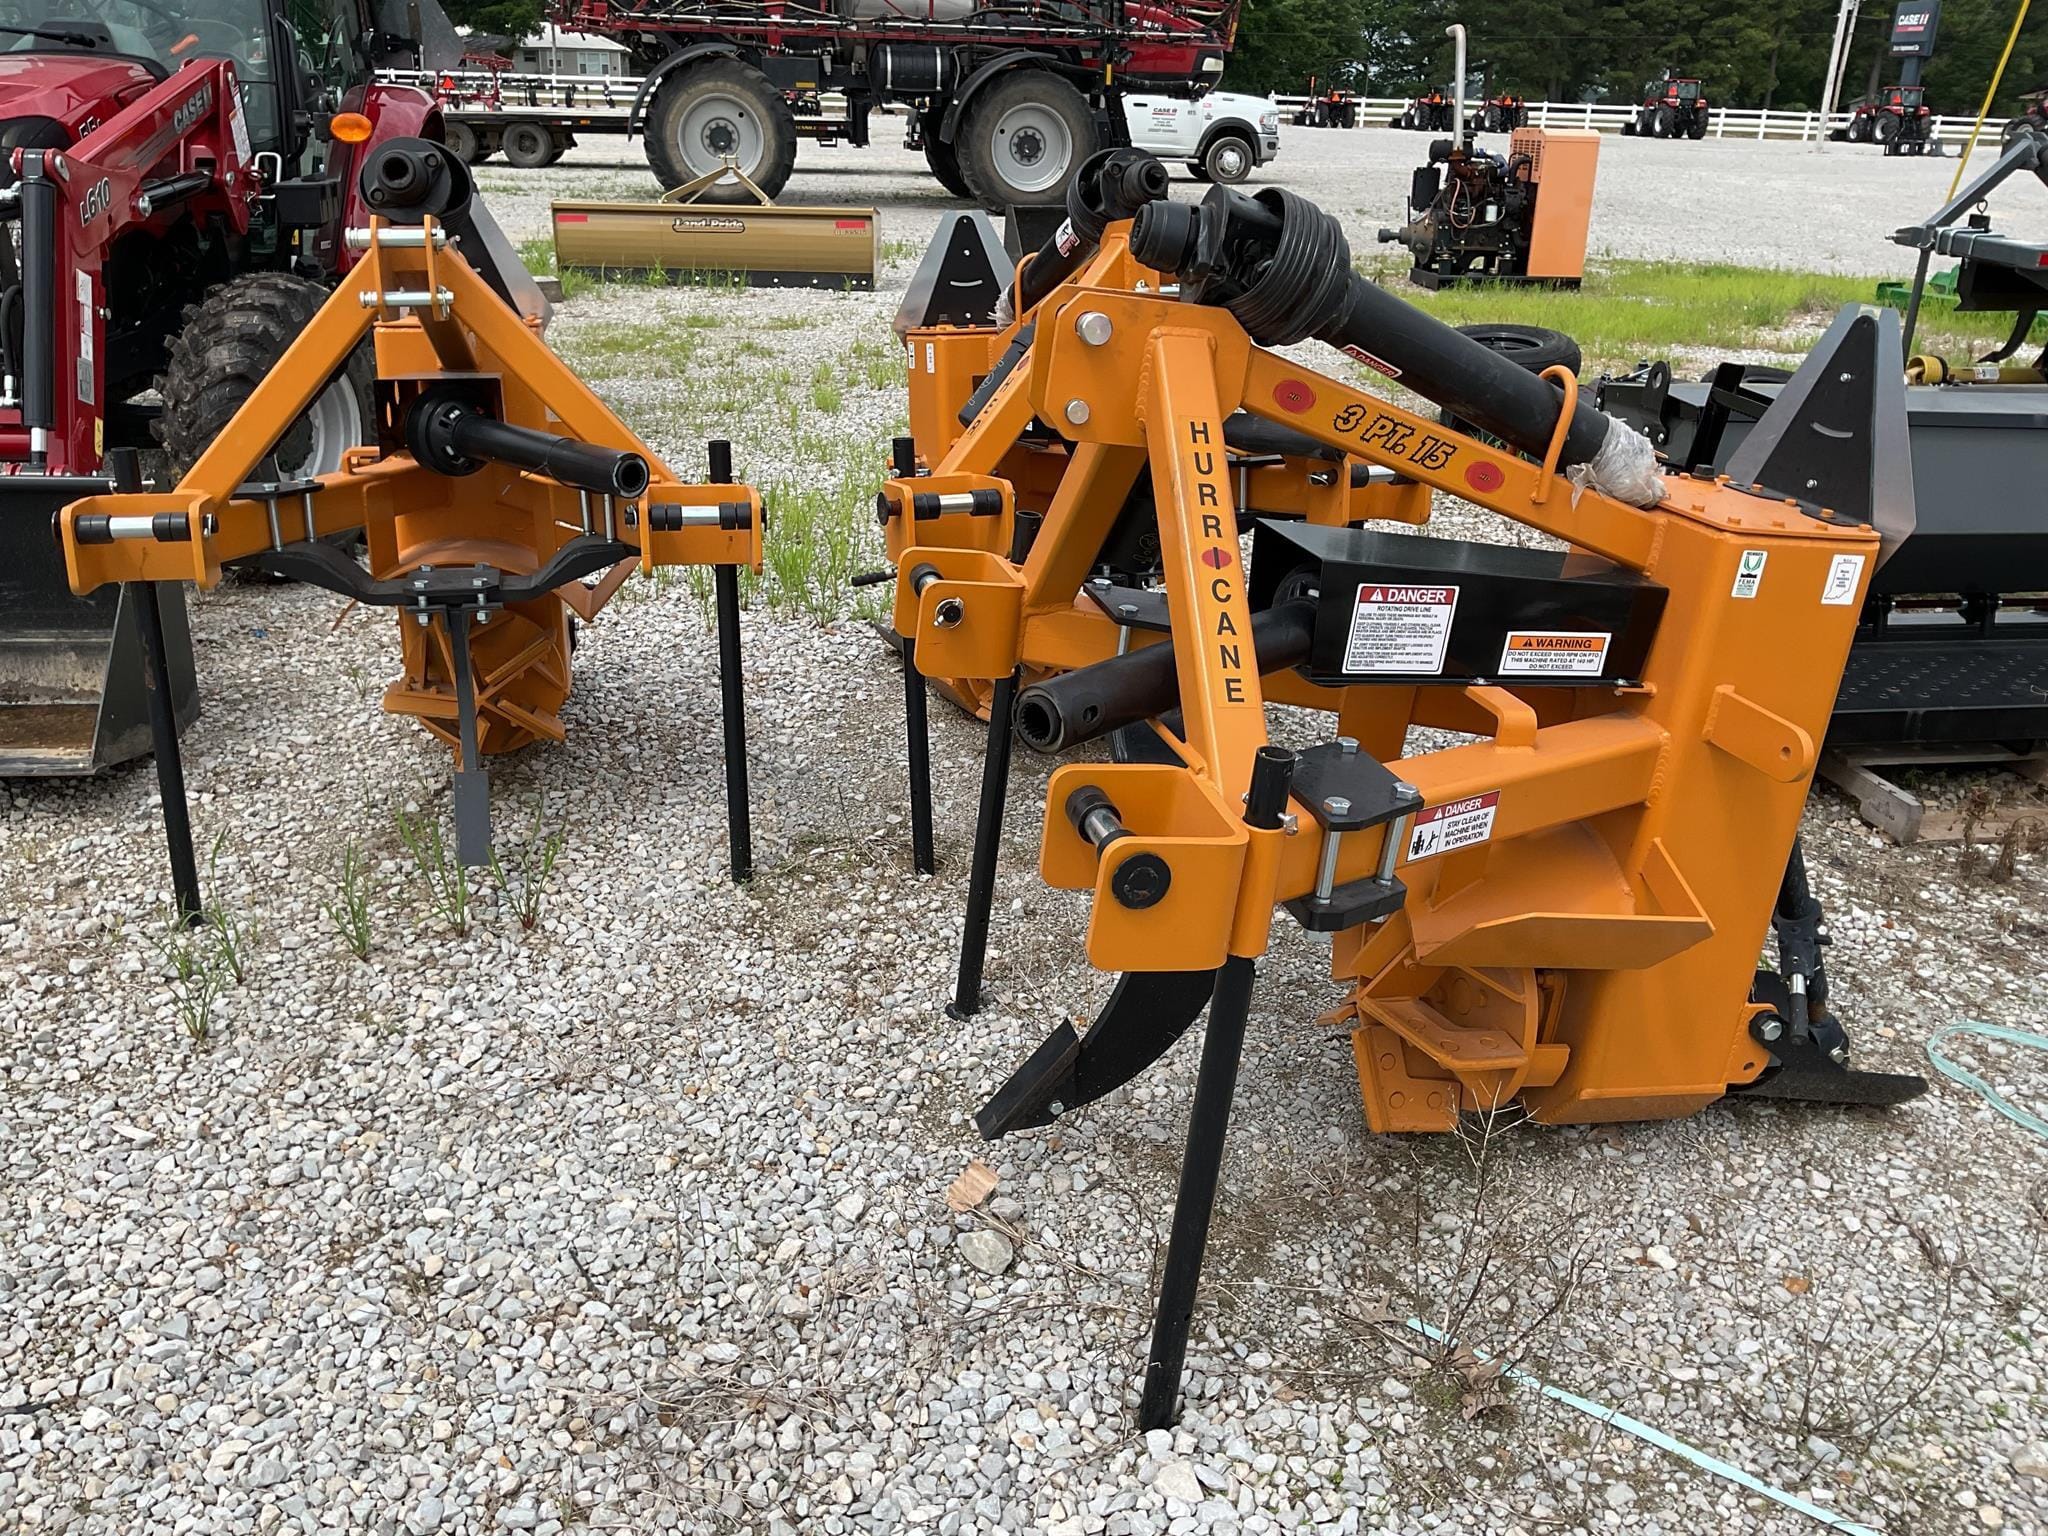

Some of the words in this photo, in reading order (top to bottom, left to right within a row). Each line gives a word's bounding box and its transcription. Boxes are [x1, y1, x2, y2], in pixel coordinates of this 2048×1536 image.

[1898, 14, 1920, 25] CASE
[173, 95, 206, 134] CASE
[80, 177, 111, 228] L610
[1355, 354, 1396, 377] DANGER
[1333, 403, 1367, 433] 3
[1408, 434, 1458, 470] 15
[1190, 421, 1245, 703] HURRICANE
[1387, 588, 1447, 603] DANGER
[1377, 605, 1402, 613] ROTATING
[1536, 639, 1592, 649] WARNING
[1444, 798, 1482, 817] DANGER
[1444, 826, 1471, 839] MACHINE
[1471, 820, 1488, 831] WHEN
[1447, 820, 1460, 830] STAY
[1461, 814, 1481, 826] CLEAR
[1481, 812, 1490, 820] OF
[1444, 840, 1451, 848] IN
[1451, 831, 1484, 846] OPERATION
